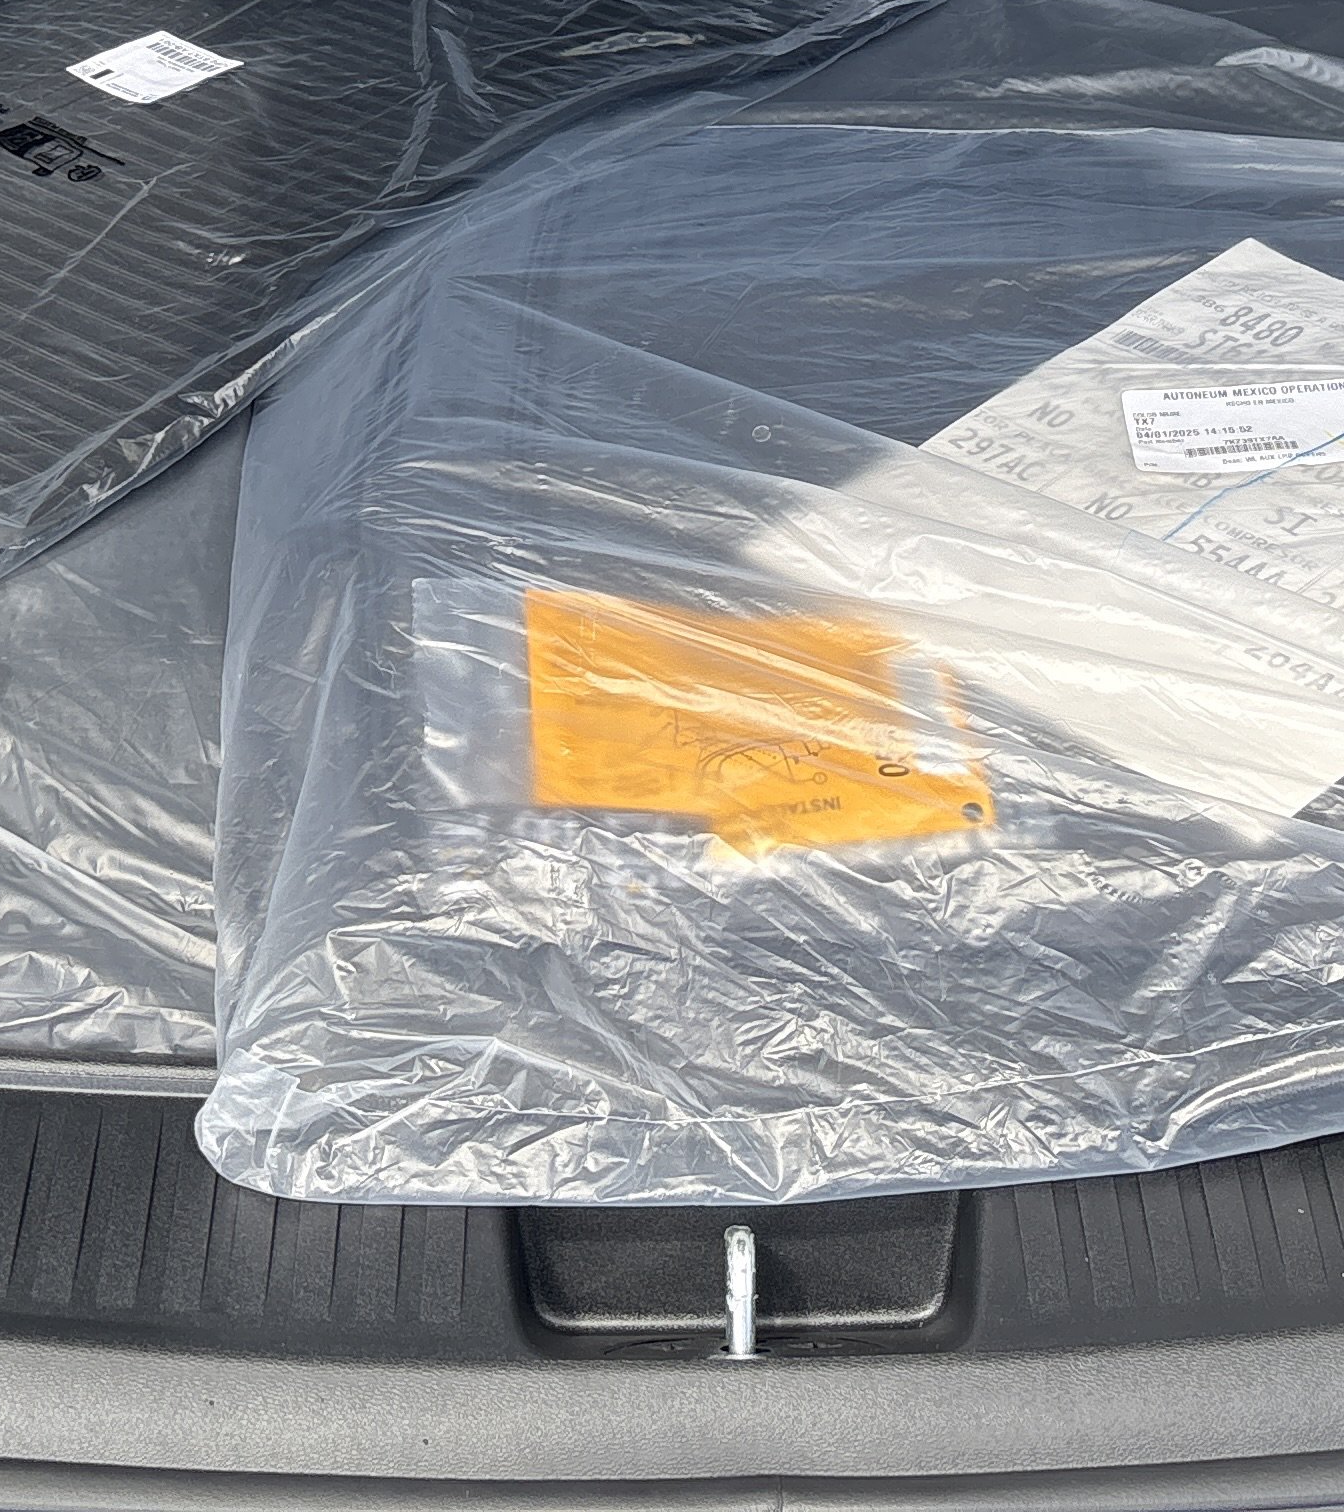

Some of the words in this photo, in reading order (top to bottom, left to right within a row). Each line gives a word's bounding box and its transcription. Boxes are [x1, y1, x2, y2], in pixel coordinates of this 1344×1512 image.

[1220, 305, 1304, 348] 8480
[1162, 390, 1228, 401] AUTONEUM
[1232, 385, 1277, 397] MEXICO
[1027, 400, 1074, 429] NO
[1133, 418, 1155, 426] TX7
[947, 428, 1047, 482] 297AC
